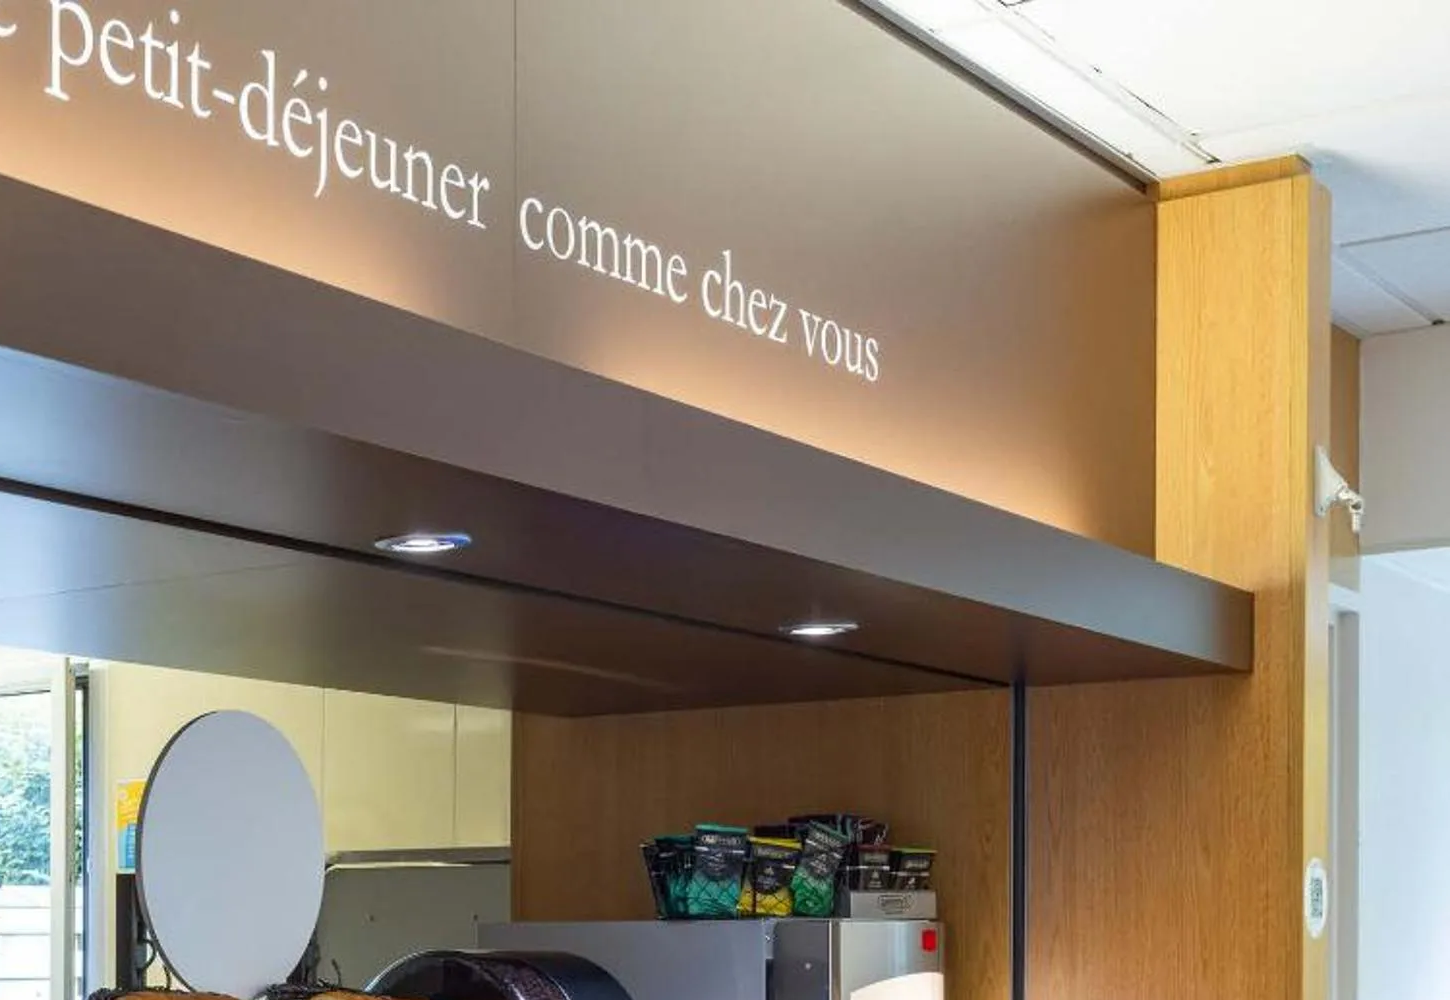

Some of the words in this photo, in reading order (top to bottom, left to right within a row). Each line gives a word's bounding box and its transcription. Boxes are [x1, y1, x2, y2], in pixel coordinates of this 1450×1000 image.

[44, 0, 490, 229] petit-déjeuner
[519, 197, 689, 304] comme
[701, 249, 787, 343] chez
[798, 308, 880, 382] vous
